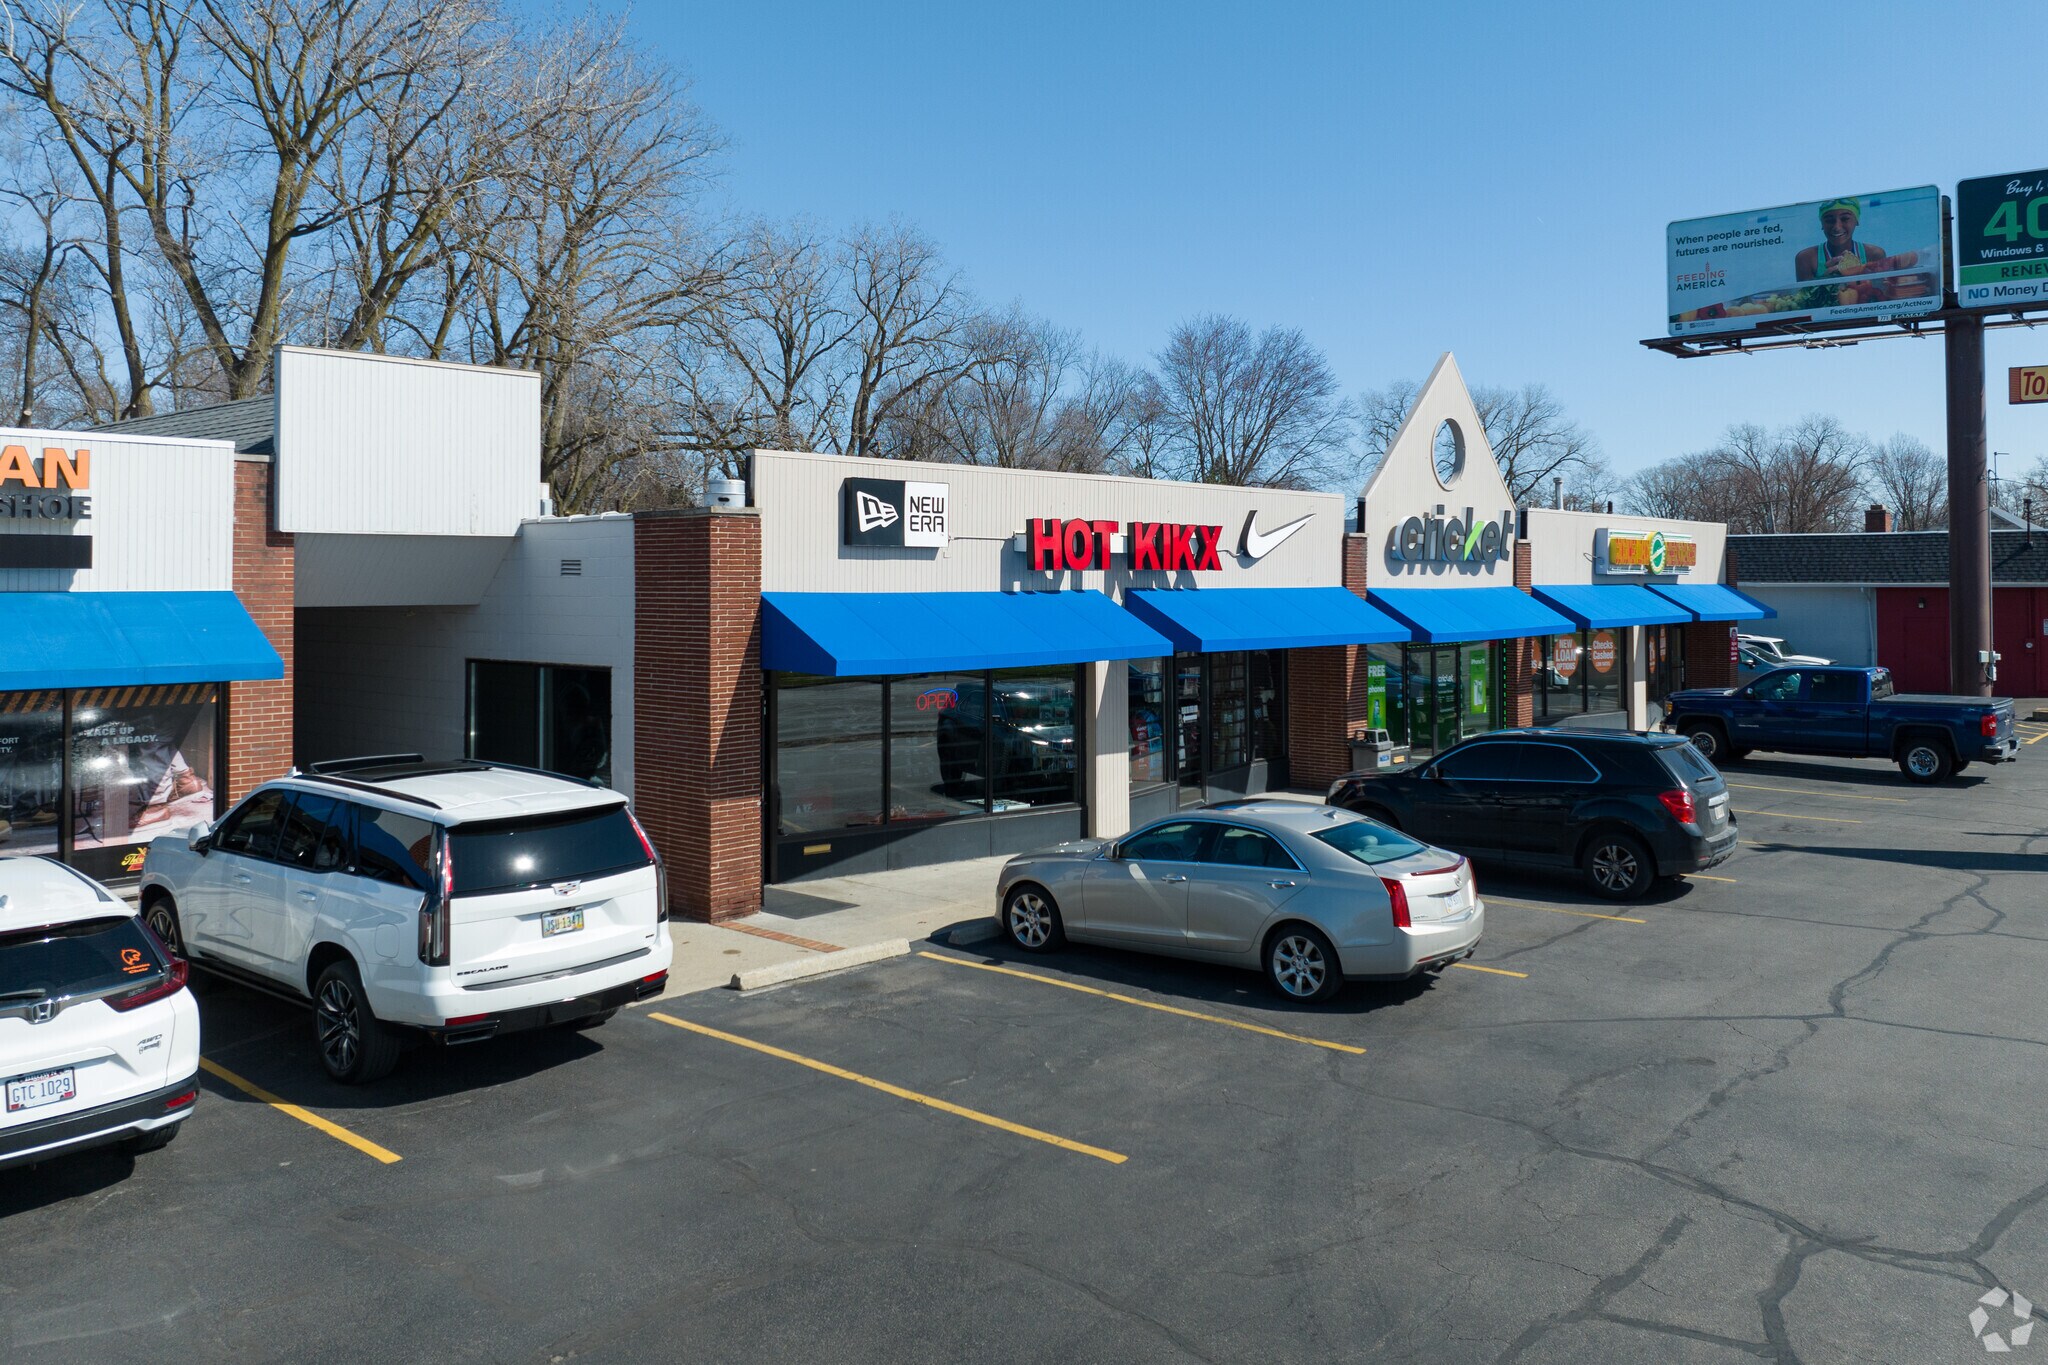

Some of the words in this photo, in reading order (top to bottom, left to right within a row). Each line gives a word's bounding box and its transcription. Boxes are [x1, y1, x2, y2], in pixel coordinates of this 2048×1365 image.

[2006, 180, 2033, 197] Buy
[1675, 235, 1704, 246] When
[1706, 230, 1741, 243] people
[1744, 227, 1760, 237] are
[1763, 223, 1784, 234] fed,
[1675, 246, 1709, 257] futures
[1712, 244, 1728, 253] are
[1731, 236, 1784, 250] nourished.
[1981, 247, 2032, 258] Windows
[2035, 243, 2044, 253] &
[1676, 267, 1726, 283] FEEDING
[1676, 279, 1726, 291] AMERICA
[1968, 287, 1989, 299] NO
[1993, 285, 2038, 297] Money
[1830, 300, 1933, 315] FeedingAmerica.org/ActNow
[2023, 371, 2048, 395] To
[0, 445, 90, 489] AN
[909, 496, 944, 513] NEW
[909, 515, 944, 532] ERA
[1395, 504, 1514, 561] cricket
[1026, 518, 1119, 571] HOT
[1127, 522, 1223, 571] KIKX
[1558, 639, 1573, 648] NEW
[1592, 640, 1613, 650] Checks
[1555, 649, 1577, 661] LOAN
[1592, 650, 1613, 660] Cashed
[1368, 665, 1386, 677] FREE
[1368, 685, 1386, 695] phones
[915, 692, 956, 711] OPEN
[119, 725, 135, 734] UP
[101, 737, 109, 746] A
[113, 735, 158, 745] LEGACY.
[456, 964, 509, 976] ESCALADE
[12, 1085, 36, 1103] GTC
[41, 1077, 71, 1098] 1029
